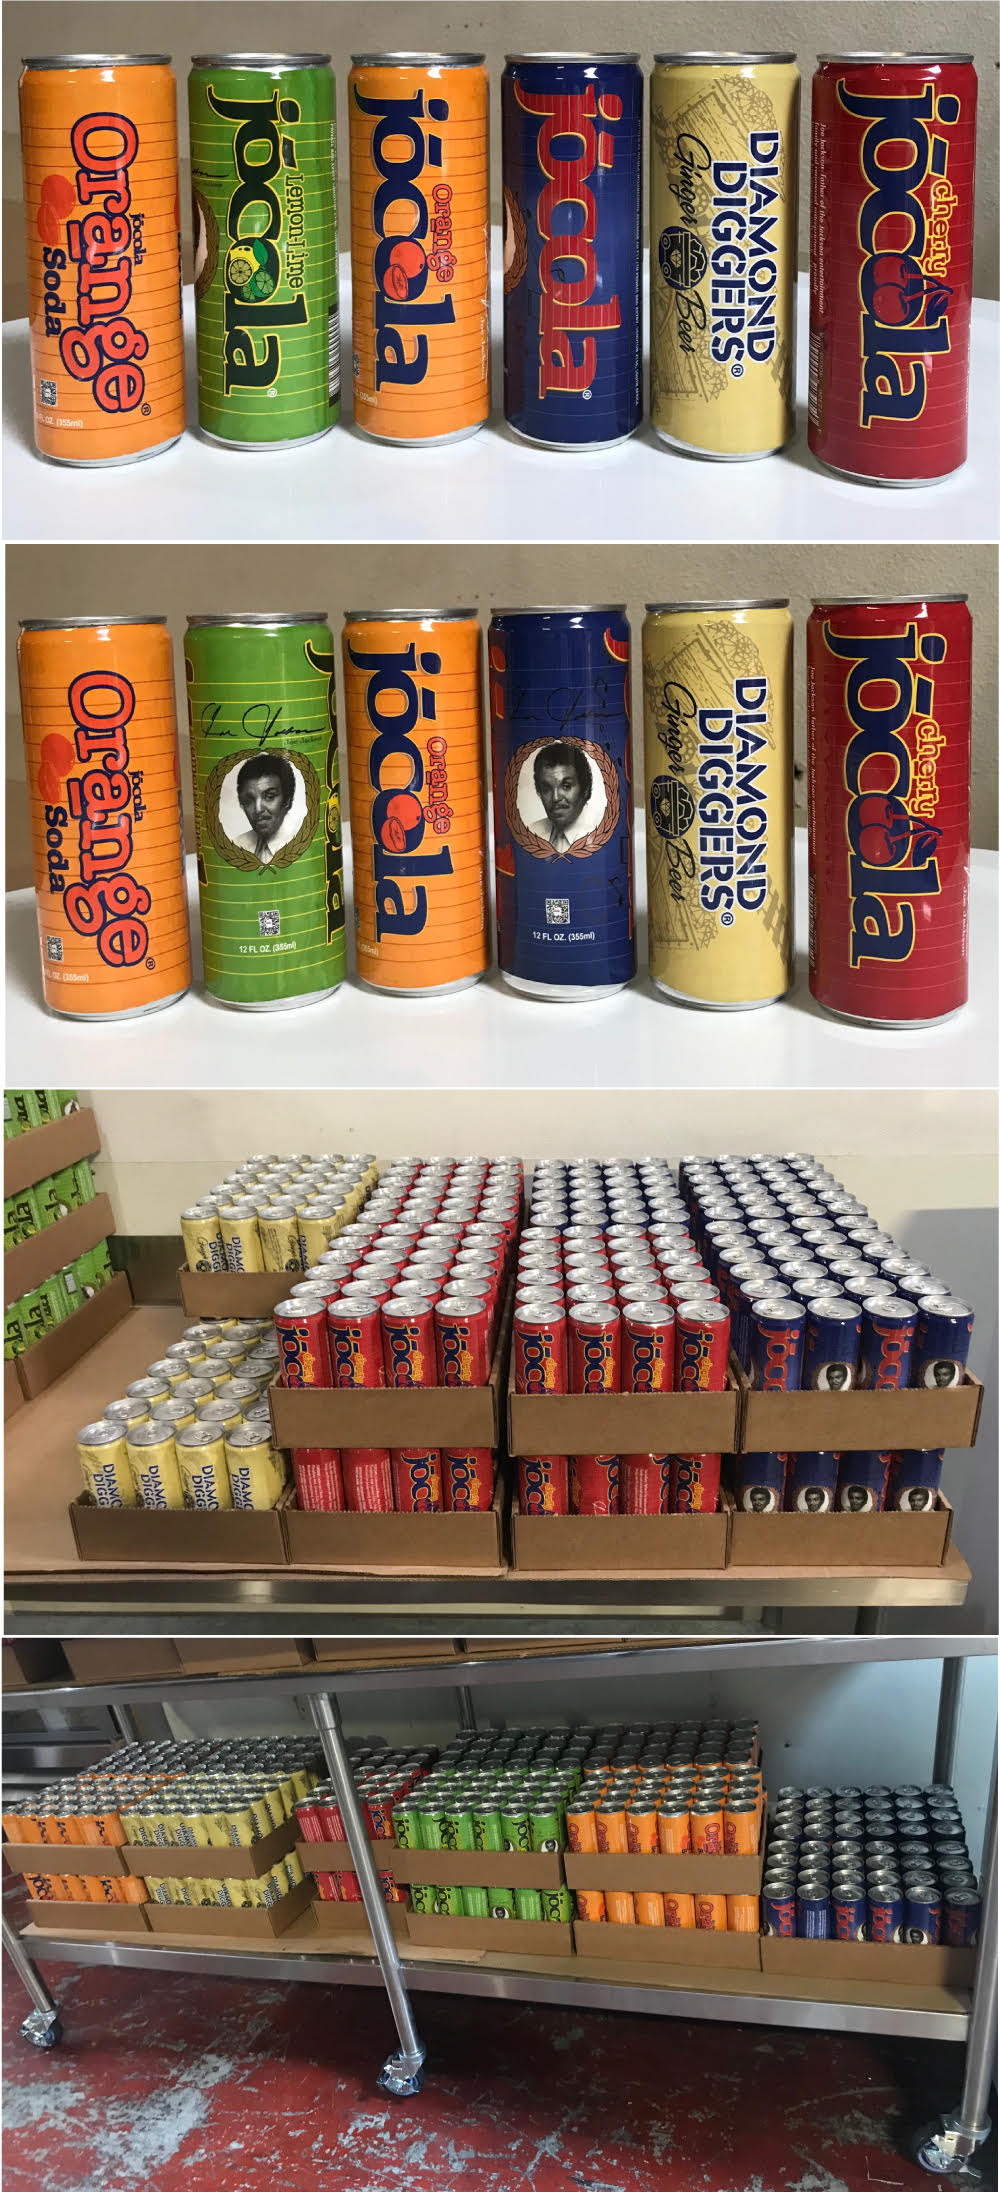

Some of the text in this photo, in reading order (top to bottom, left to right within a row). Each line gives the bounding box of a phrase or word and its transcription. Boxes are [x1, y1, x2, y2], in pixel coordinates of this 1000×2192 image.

[668, 131, 712, 229] Ginger
[922, 178, 958, 279] cherry
[59, 111, 149, 413] Orange
[428, 183, 458, 283] Orange
[710, 160, 749, 365] DIGGERS
[745, 130, 781, 364] DIAMOND
[43, 246, 62, 337] Soda
[675, 287, 707, 358] Beer
[660, 681, 697, 777] Ginger
[912, 718, 946, 819] cherry
[63, 670, 152, 968] Orange
[426, 736, 455, 836] Orange
[696, 708, 736, 914] DIGGERS
[733, 676, 769, 913] DIAMOND
[45, 804, 67, 895] Soda
[665, 837, 697, 904] Beer
[239, 945, 247, 953] 12
[249, 945, 258, 953] FL
[272, 941, 297, 952] (355ml)
[532, 931, 595, 942] 12 FL OZ. (355ml)
